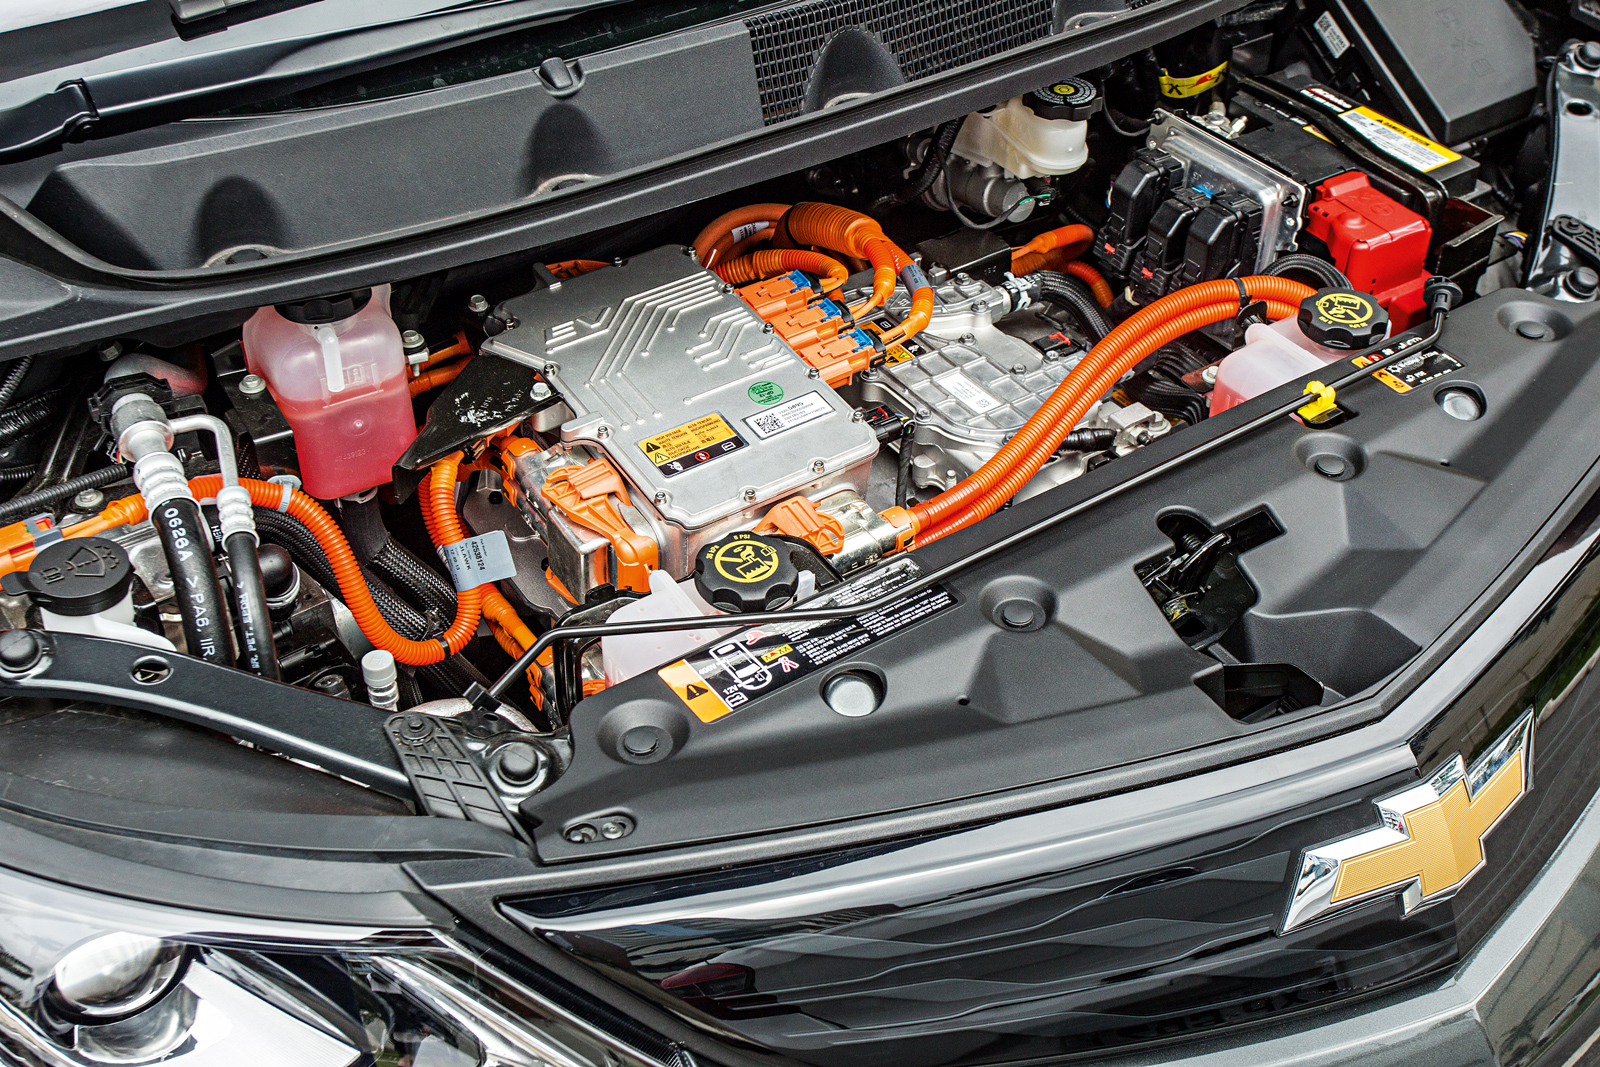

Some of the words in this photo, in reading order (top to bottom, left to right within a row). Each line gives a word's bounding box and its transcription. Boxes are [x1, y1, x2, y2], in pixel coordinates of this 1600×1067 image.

[543, 306, 612, 345] EV
[164, 508, 194, 562] 0626A
[698, 662, 717, 676] 400V
[723, 684, 739, 695] 12V
